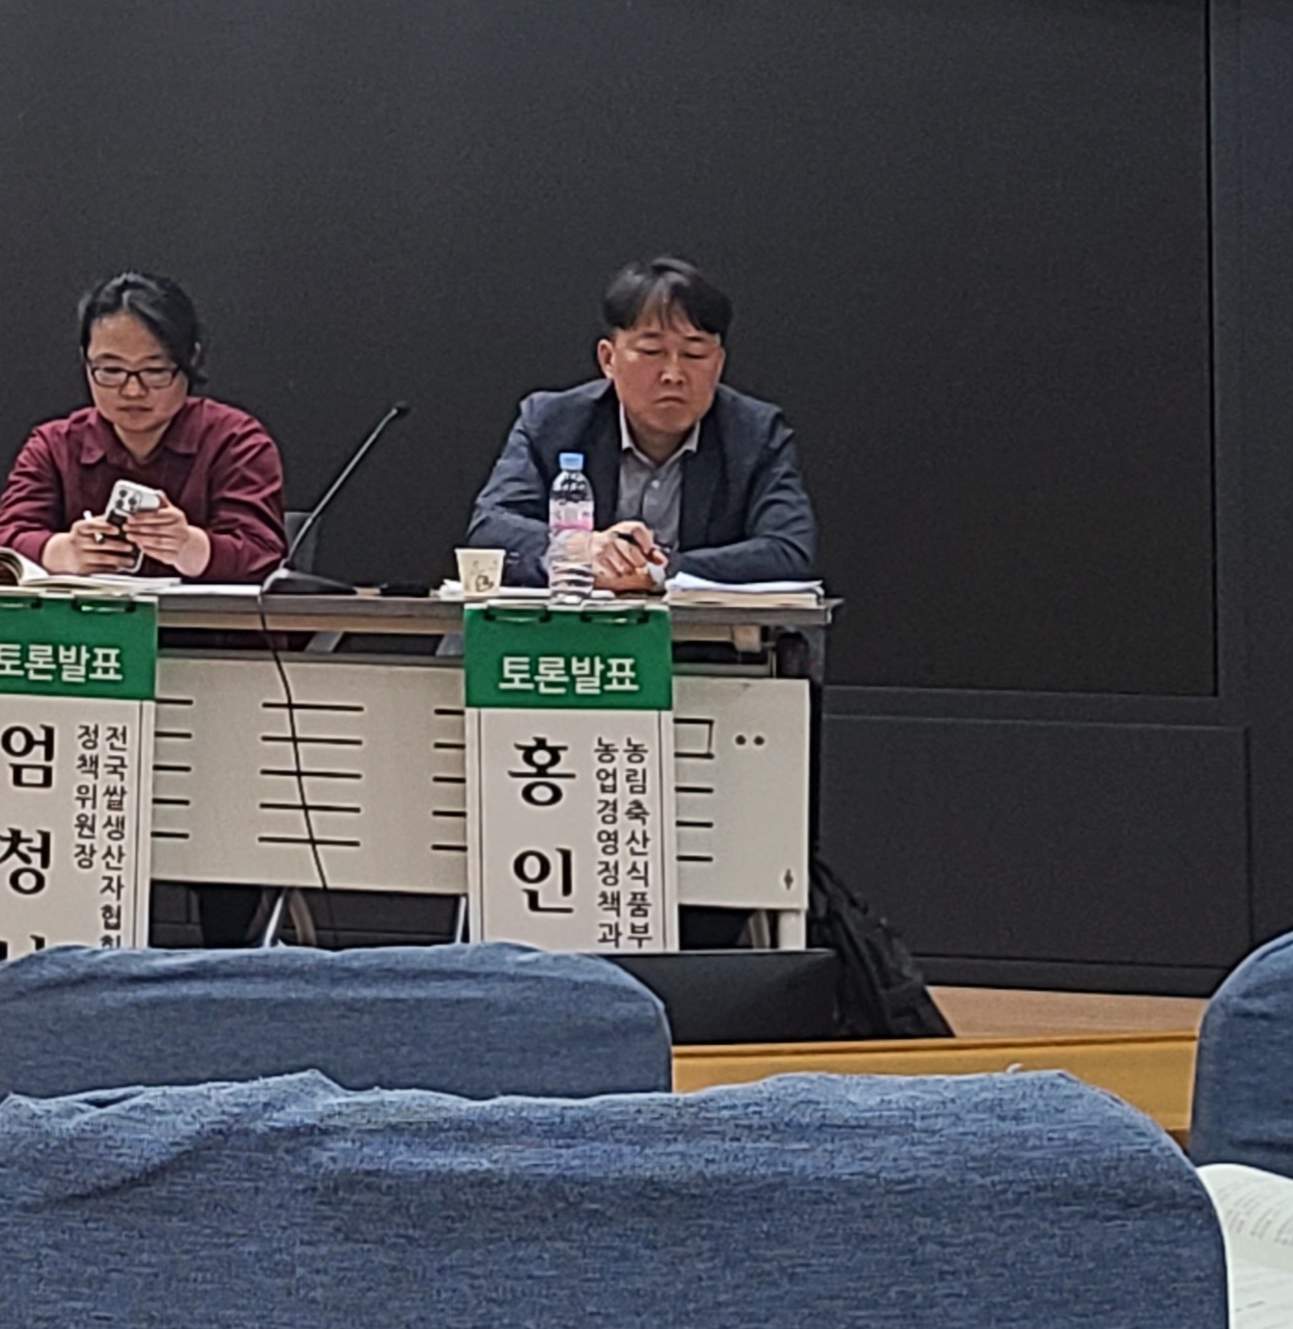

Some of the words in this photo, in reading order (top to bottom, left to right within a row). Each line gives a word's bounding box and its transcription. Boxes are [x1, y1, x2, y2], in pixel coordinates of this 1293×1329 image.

[498, 655, 640, 695] 토론발표
[73, 723, 100, 870] 정책위원장
[593, 736, 623, 950] 농업경영정책과
[623, 737, 654, 950] 농림축산식품부
